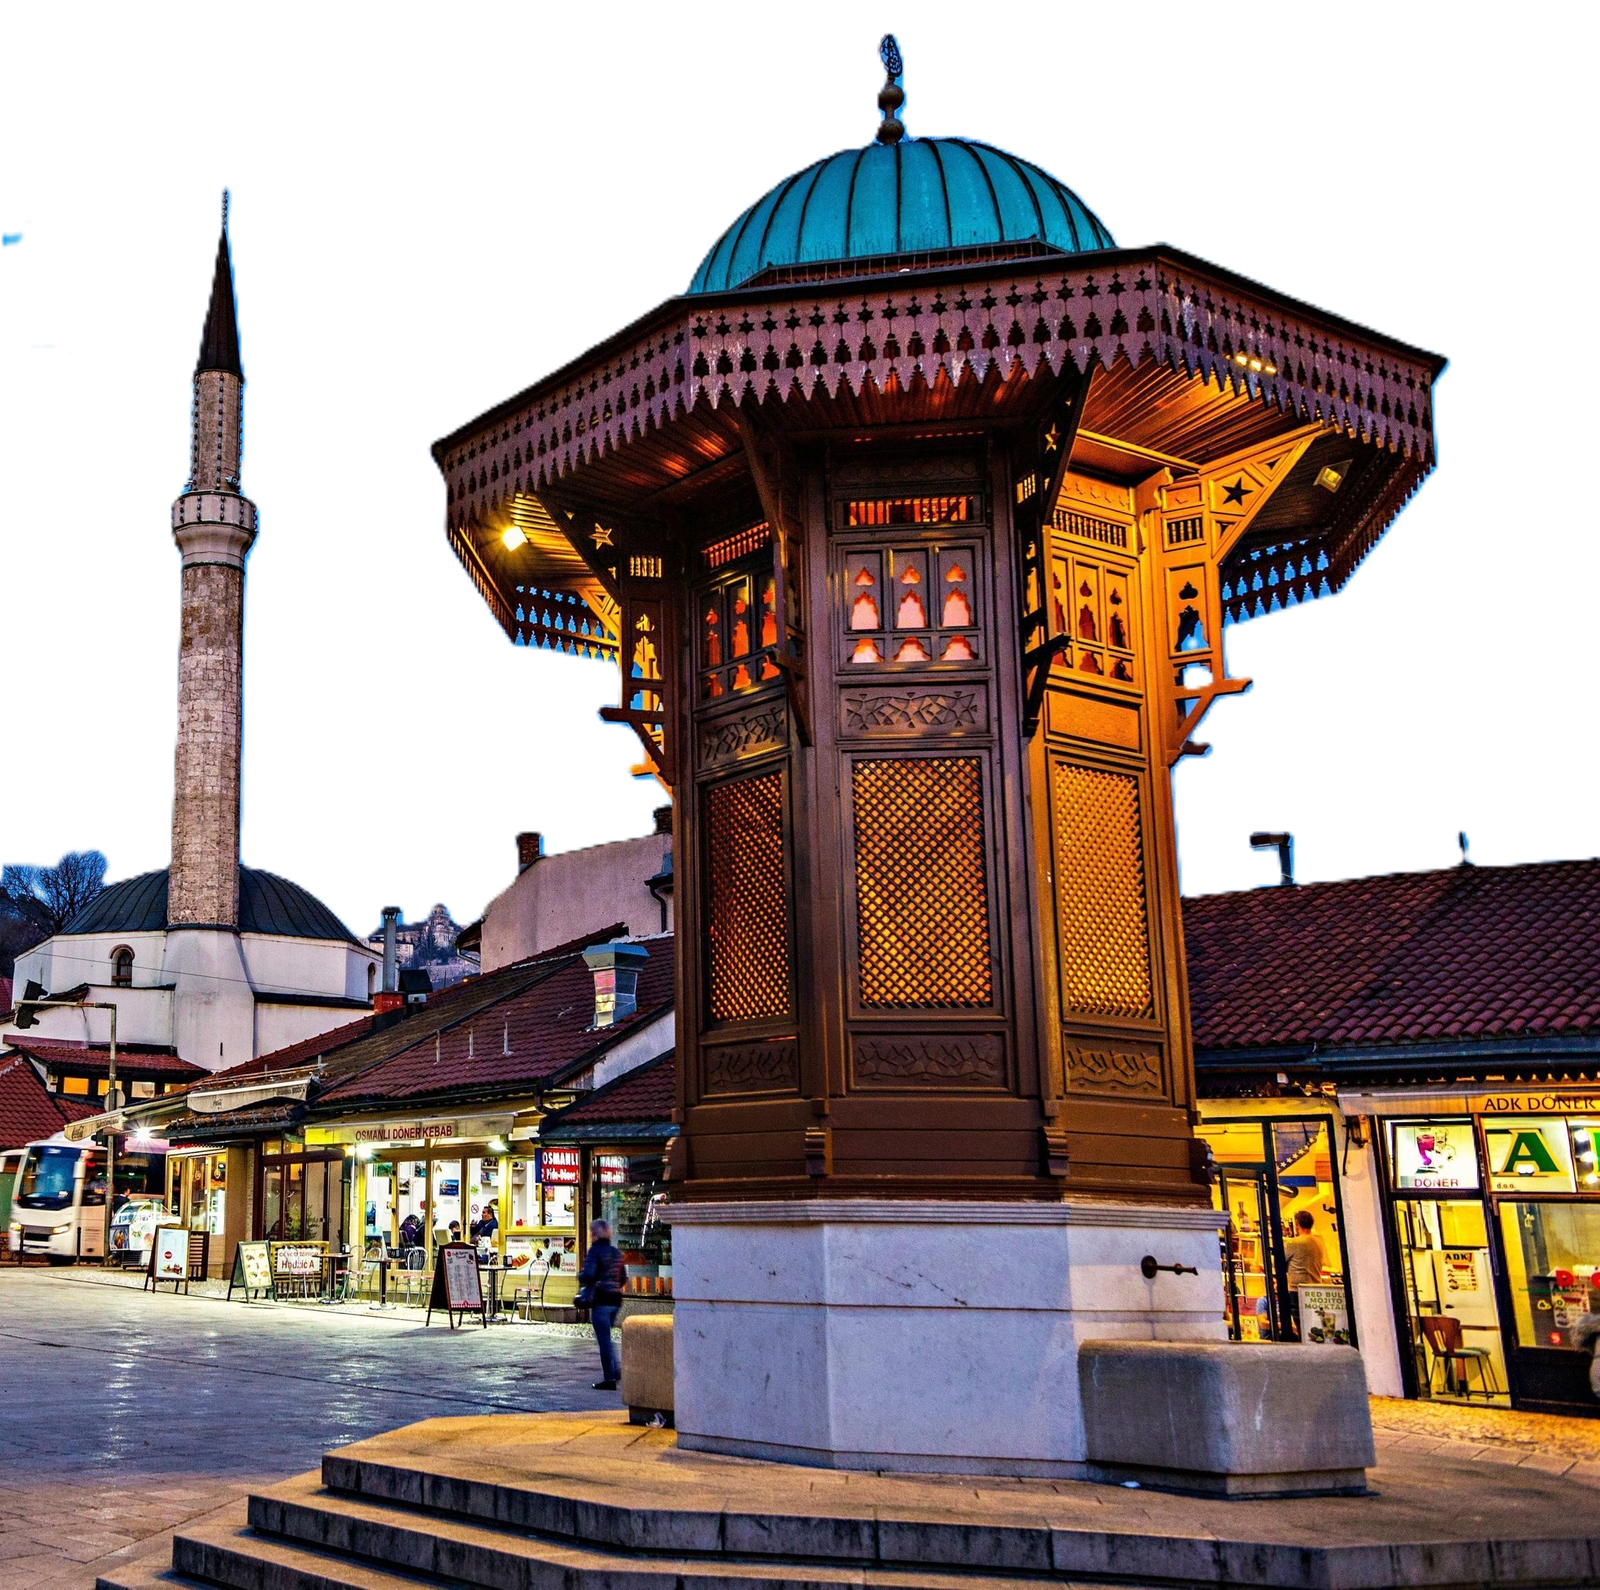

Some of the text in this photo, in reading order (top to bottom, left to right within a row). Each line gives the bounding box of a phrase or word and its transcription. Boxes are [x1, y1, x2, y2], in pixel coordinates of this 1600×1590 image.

[1484, 1095, 1596, 1110] ADK DÖNER
[355, 1125, 452, 1141] OSMANLI DÖNER KEBAB
[542, 1151, 578, 1166] OSMANLI
